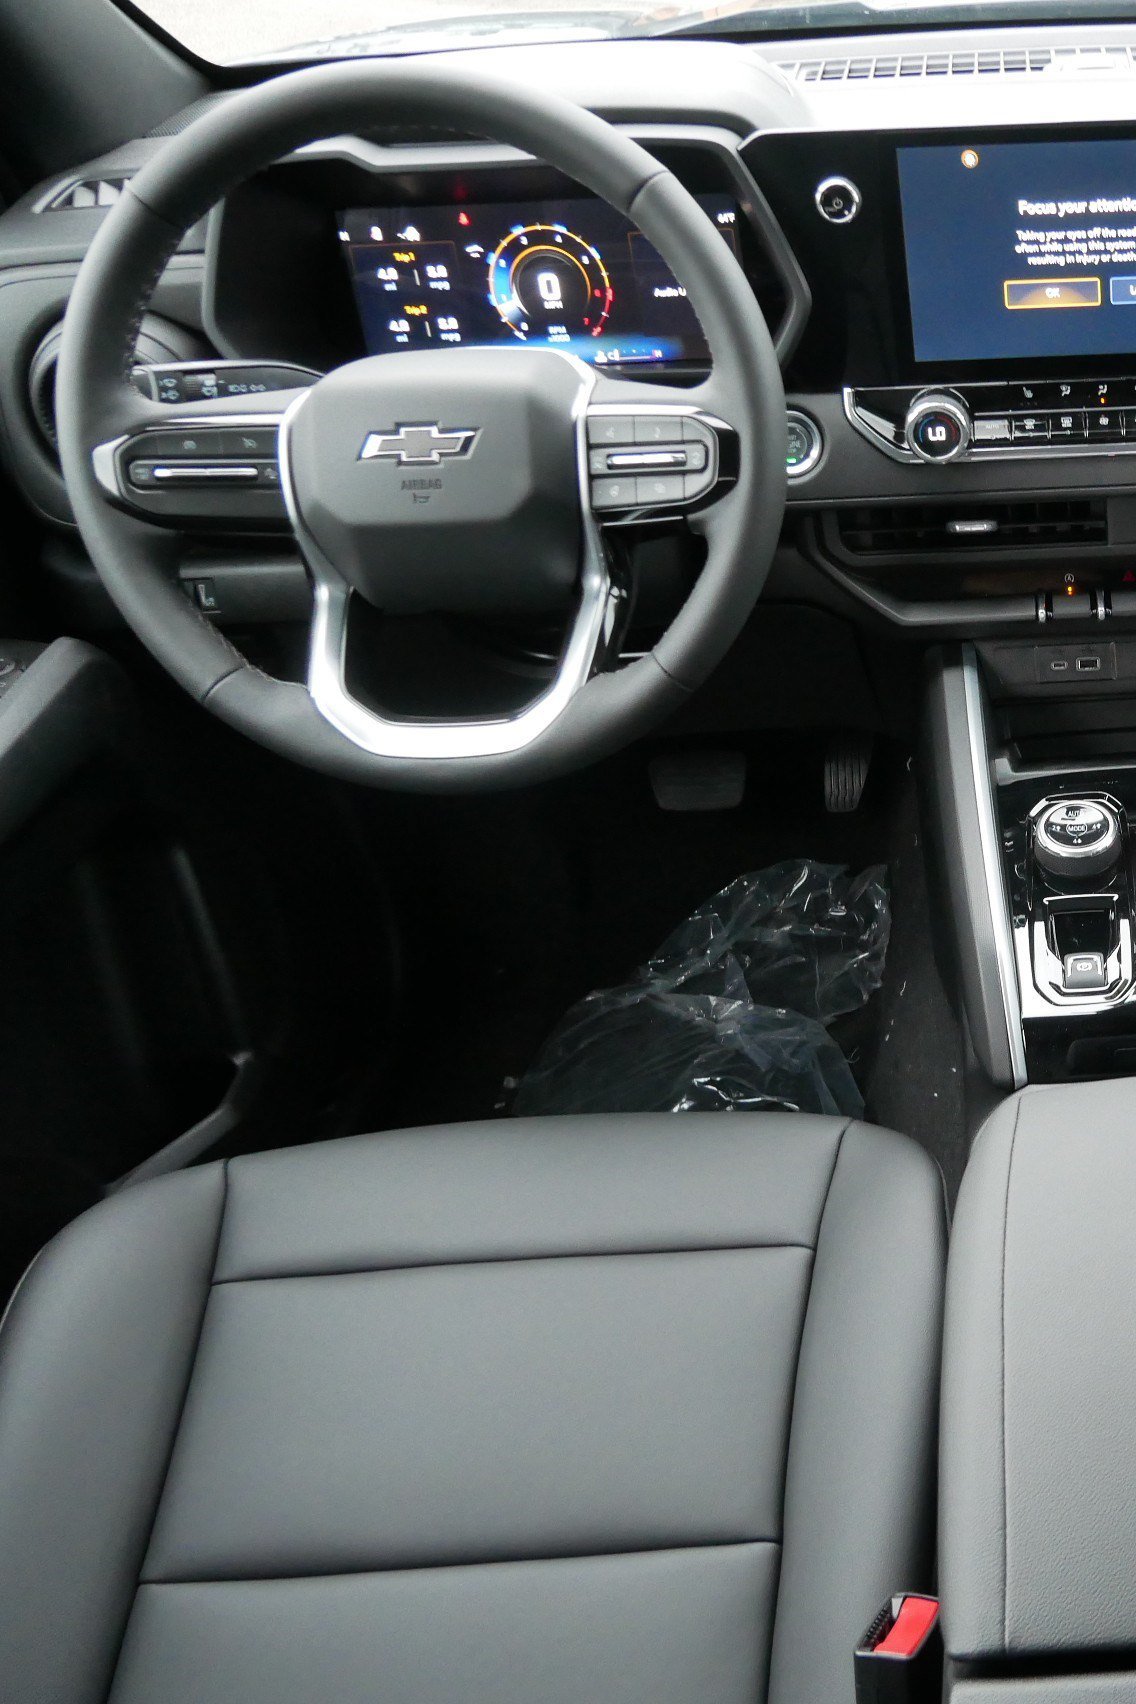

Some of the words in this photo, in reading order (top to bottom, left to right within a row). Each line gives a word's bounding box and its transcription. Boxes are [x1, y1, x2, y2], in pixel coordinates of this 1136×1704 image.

[1018, 199, 1057, 215] Focus
[1058, 201, 1087, 217] your
[1016, 229, 1045, 242] Taking
[1046, 231, 1065, 243] your
[1066, 230, 1086, 242] eyes
[1101, 227, 1116, 238] the
[1117, 226, 1136, 237] road
[1039, 241, 1063, 253] while
[1063, 241, 1087, 253] using
[1087, 240, 1105, 251] this
[1105, 240, 1136, 252] system
[1027, 253, 1065, 267] resulting
[1065, 253, 1075, 264] in
[1075, 252, 1100, 266] injury
[1100, 253, 1111, 263] or
[1111, 251, 1136, 263] death
[537, 272, 562, 300] 0
[1045, 287, 1060, 298] OK
[400, 479, 442, 490] AIRBAG
